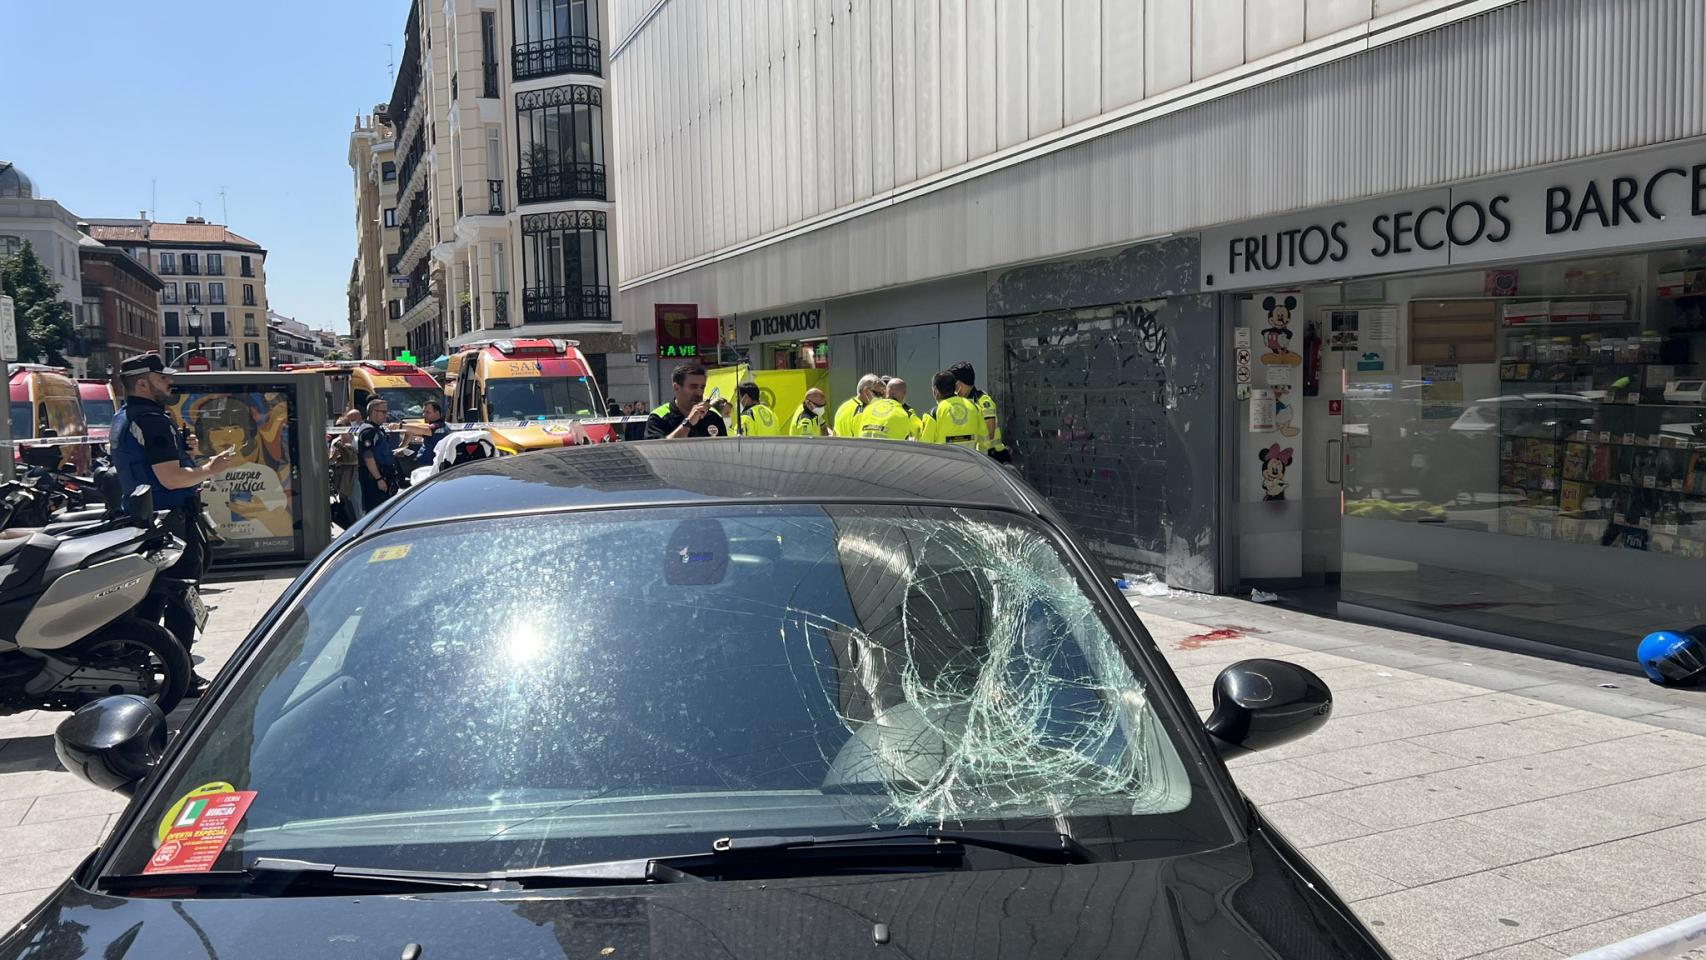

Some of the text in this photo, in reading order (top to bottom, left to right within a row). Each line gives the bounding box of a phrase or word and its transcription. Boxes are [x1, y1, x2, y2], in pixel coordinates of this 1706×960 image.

[1228, 221, 1349, 275] FRUTOS
[1370, 195, 1512, 258] SECOS
[762, 309, 822, 337] TECHNOLOGY
[167, 830, 192, 841] OFERTA
[194, 828, 228, 838] ESPECIAL
